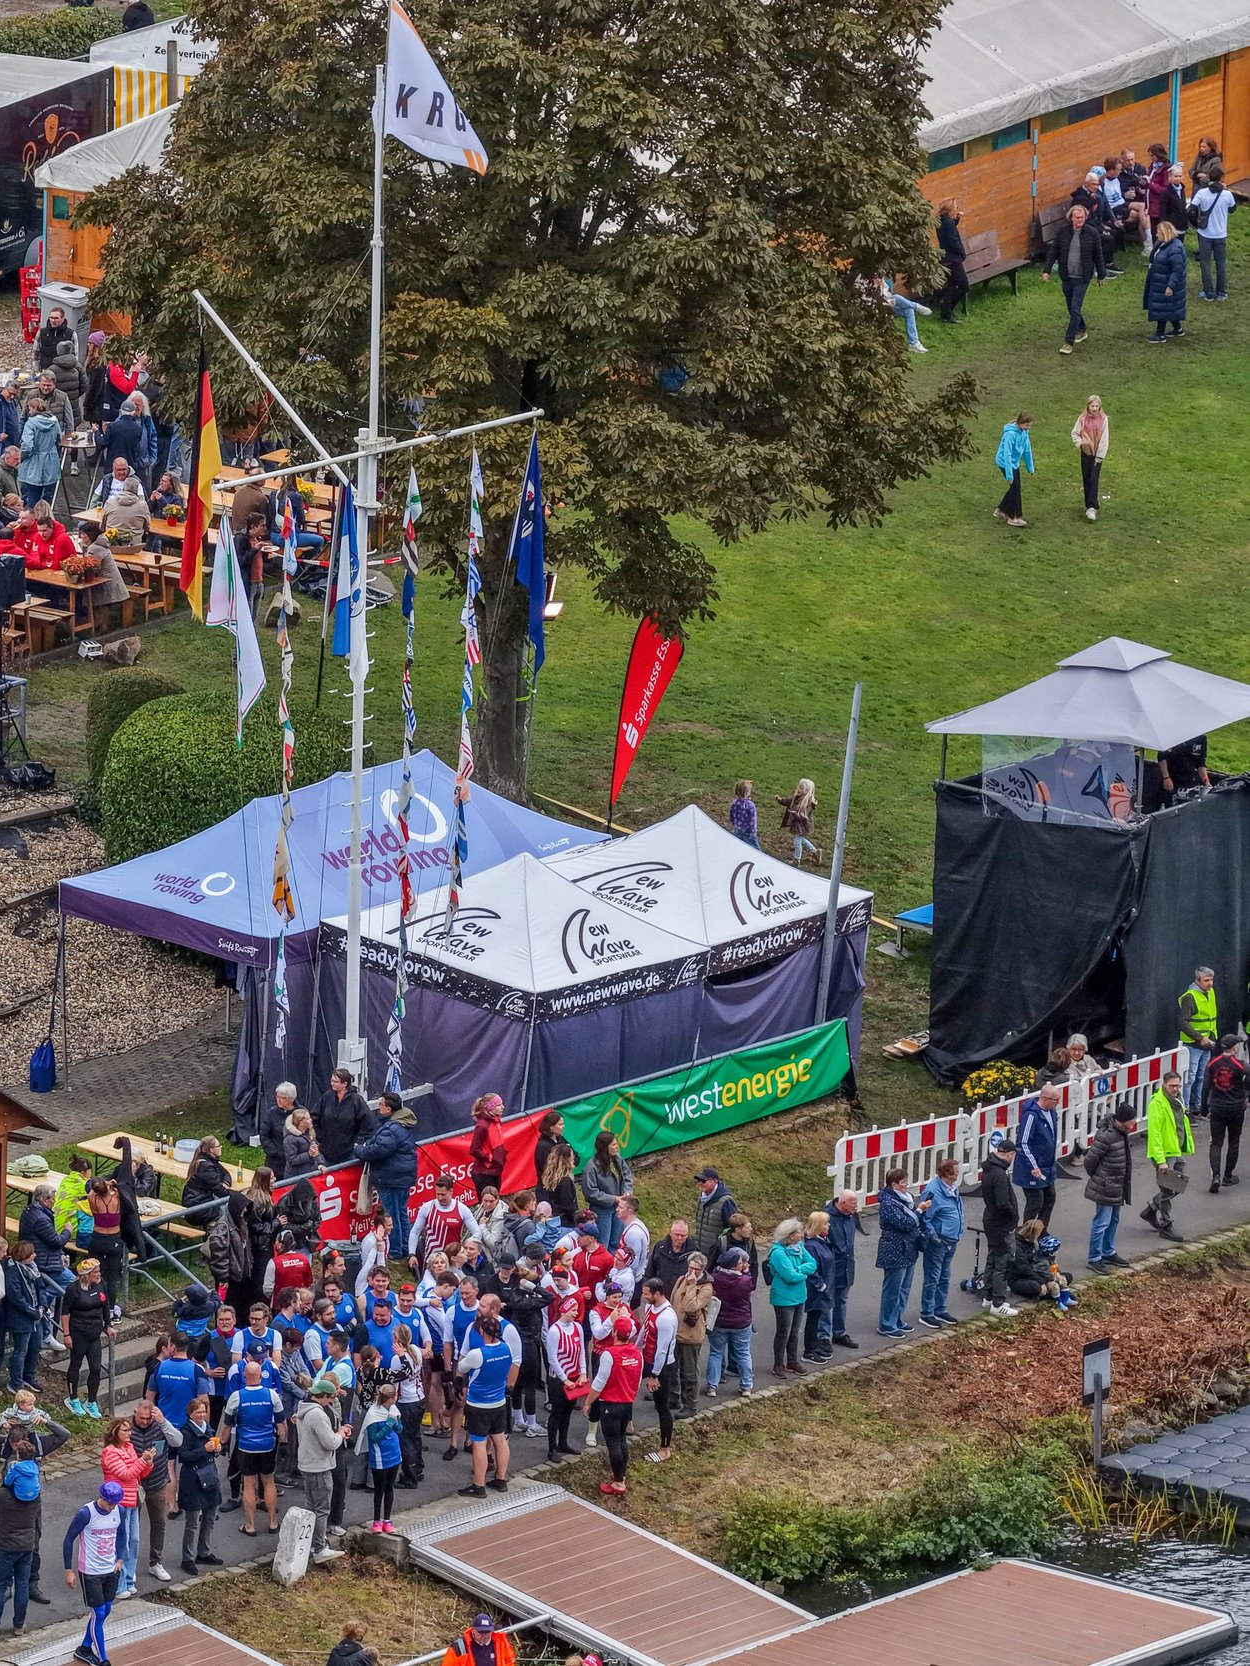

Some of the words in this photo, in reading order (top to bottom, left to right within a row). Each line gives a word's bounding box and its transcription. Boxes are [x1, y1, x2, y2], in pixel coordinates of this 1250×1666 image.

[154, 46, 210, 61] Zeverleih
[635, 661, 662, 727] Sparkasse
[154, 871, 200, 888] world
[152, 883, 206, 905] rowing
[591, 889, 649, 915] SPORTSWEAR
[760, 899, 809, 917] SPORTSWEAR
[721, 927, 804, 963] #readytorow
[337, 936, 446, 984] #eadyorow
[592, 949, 643, 967] SPORTSWEAR
[552, 973, 661, 1012] www.newwave.de
[664, 1053, 813, 1125] westenergie
[299, 1524, 312, 1540] 22
